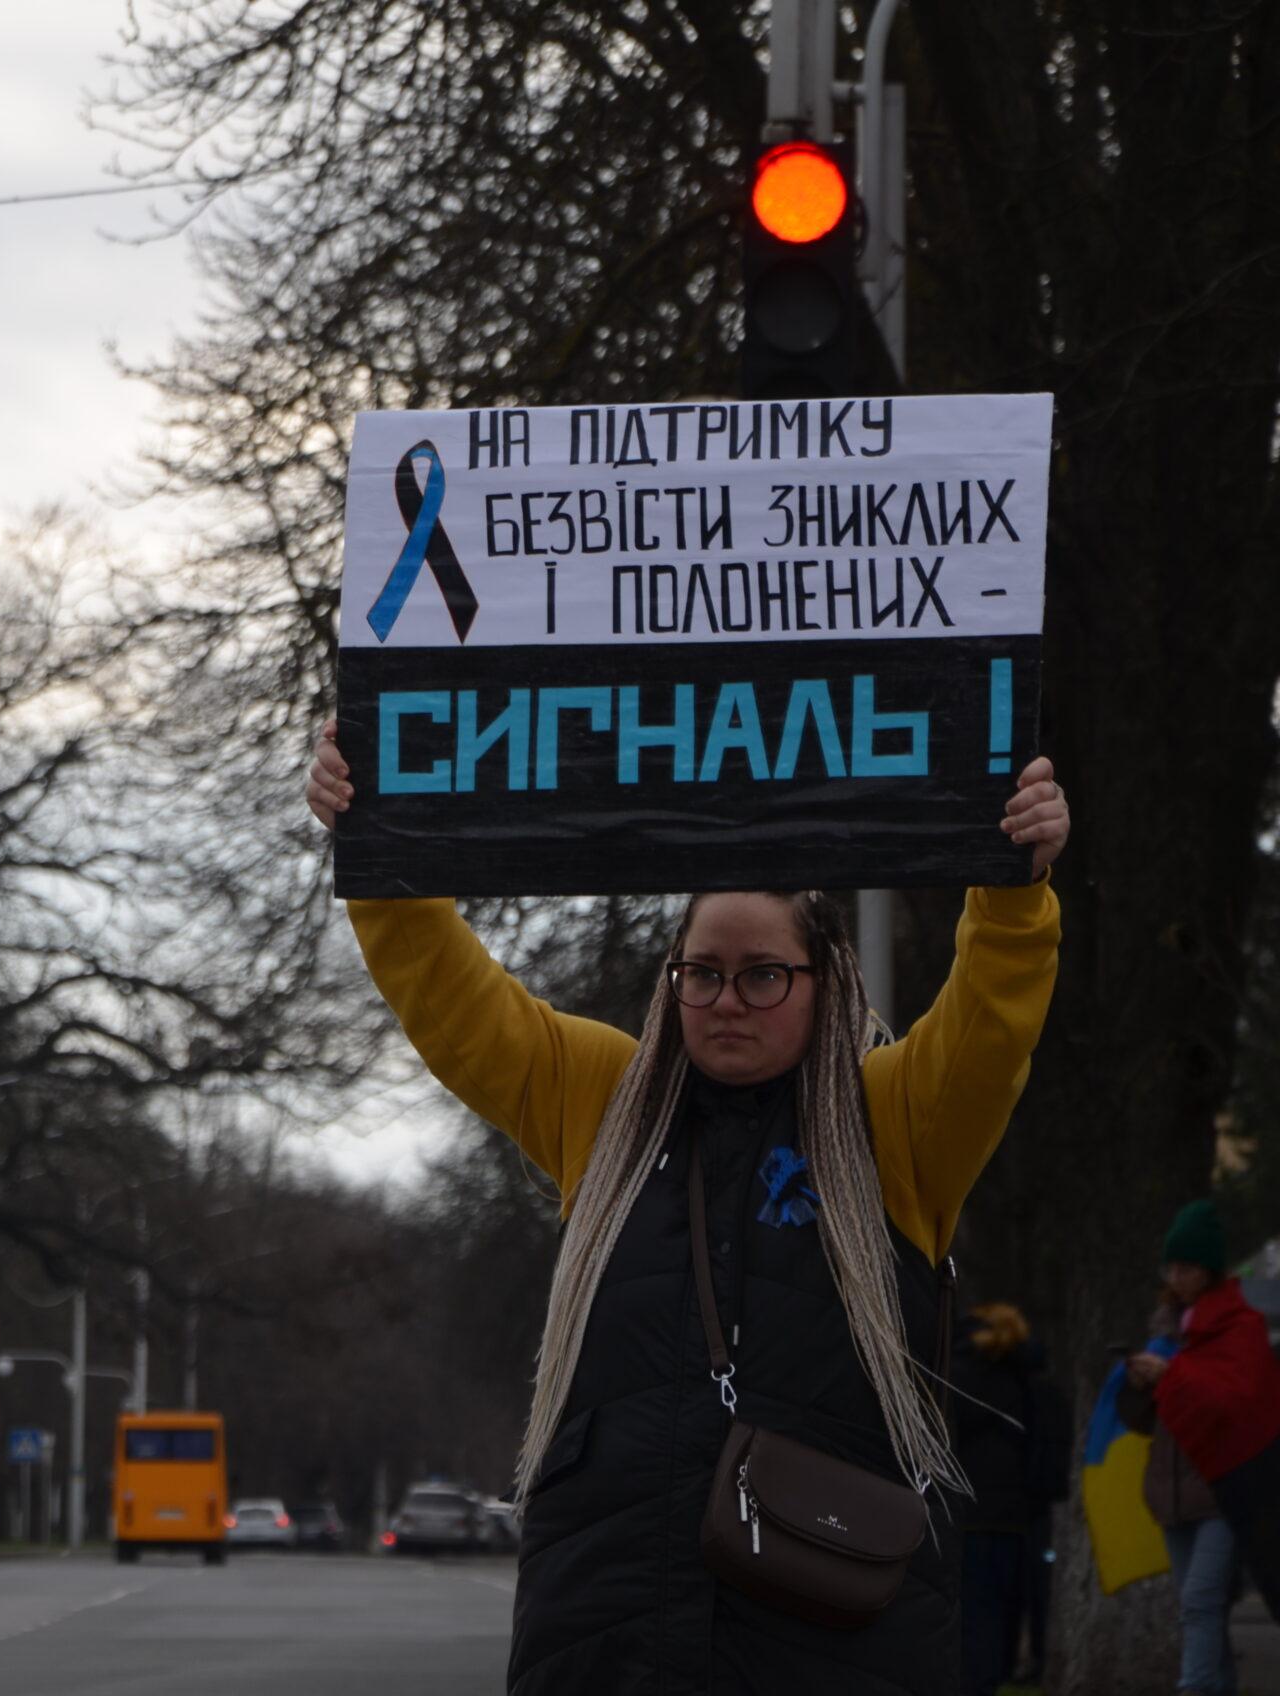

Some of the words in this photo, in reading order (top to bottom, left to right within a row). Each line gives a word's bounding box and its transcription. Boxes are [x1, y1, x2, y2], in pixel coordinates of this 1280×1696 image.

[468, 410, 530, 470] НА
[570, 399, 893, 469] ПІДТРИМКУ
[486, 480, 733, 557] БЕЗВІСТИ
[763, 479, 1021, 547] ЗНИКЛИХ
[544, 561, 557, 634] І
[612, 556, 956, 634] ПОЛОНЕНИХ
[378, 674, 929, 794] СИГНАЛЬ
